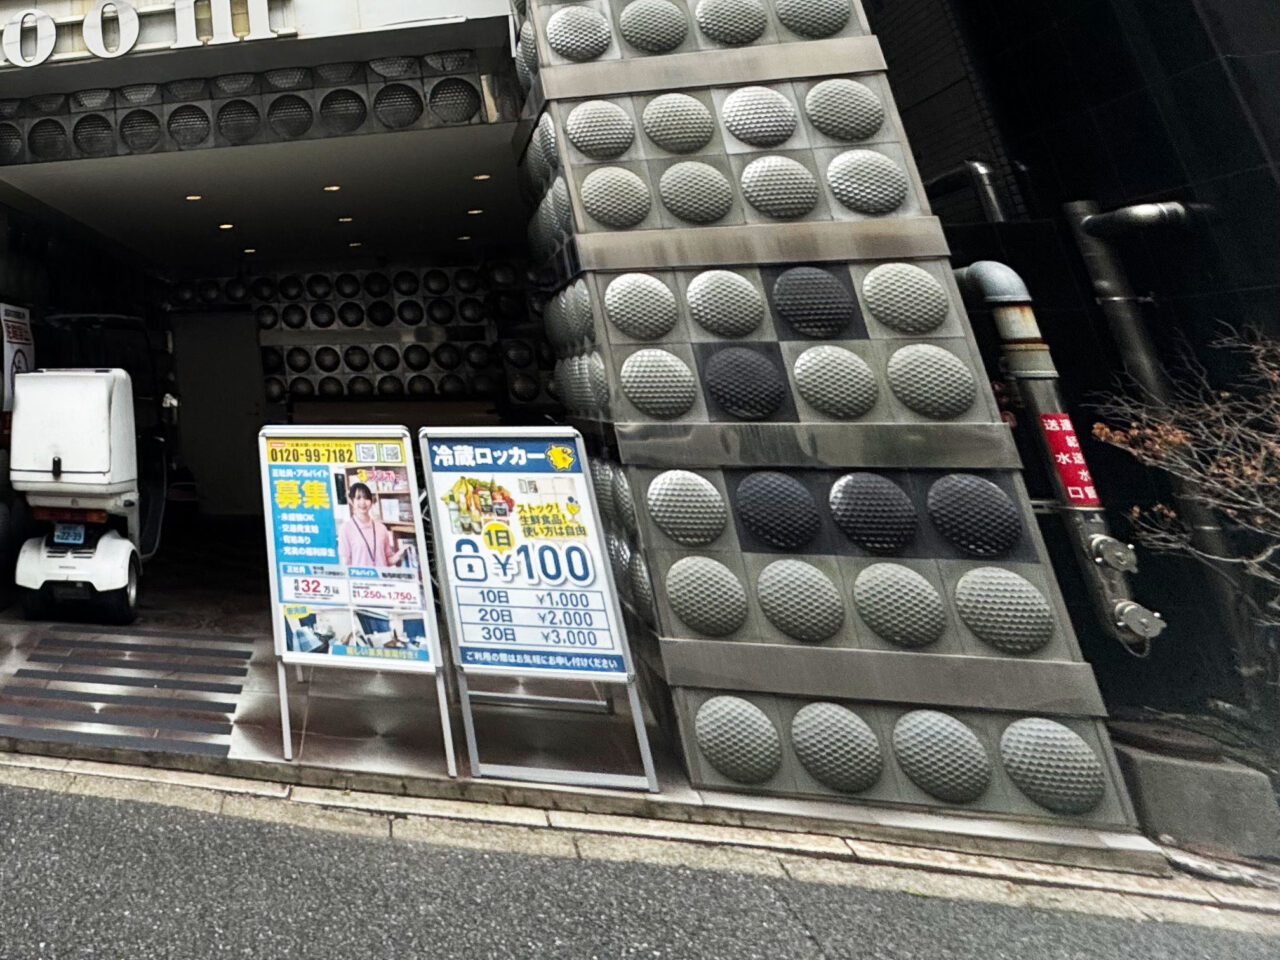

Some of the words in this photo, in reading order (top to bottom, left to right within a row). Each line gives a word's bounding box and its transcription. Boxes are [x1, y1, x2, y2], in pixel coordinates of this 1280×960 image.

[271, 448, 354, 463] 0120-99-7182
[431, 445, 546, 467] 冷蔵ロッカー
[274, 480, 330, 509] 募集
[484, 530, 511, 547] 1日
[479, 590, 510, 604] 10日
[478, 608, 513, 623] 20日
[481, 627, 517, 642] 30日
